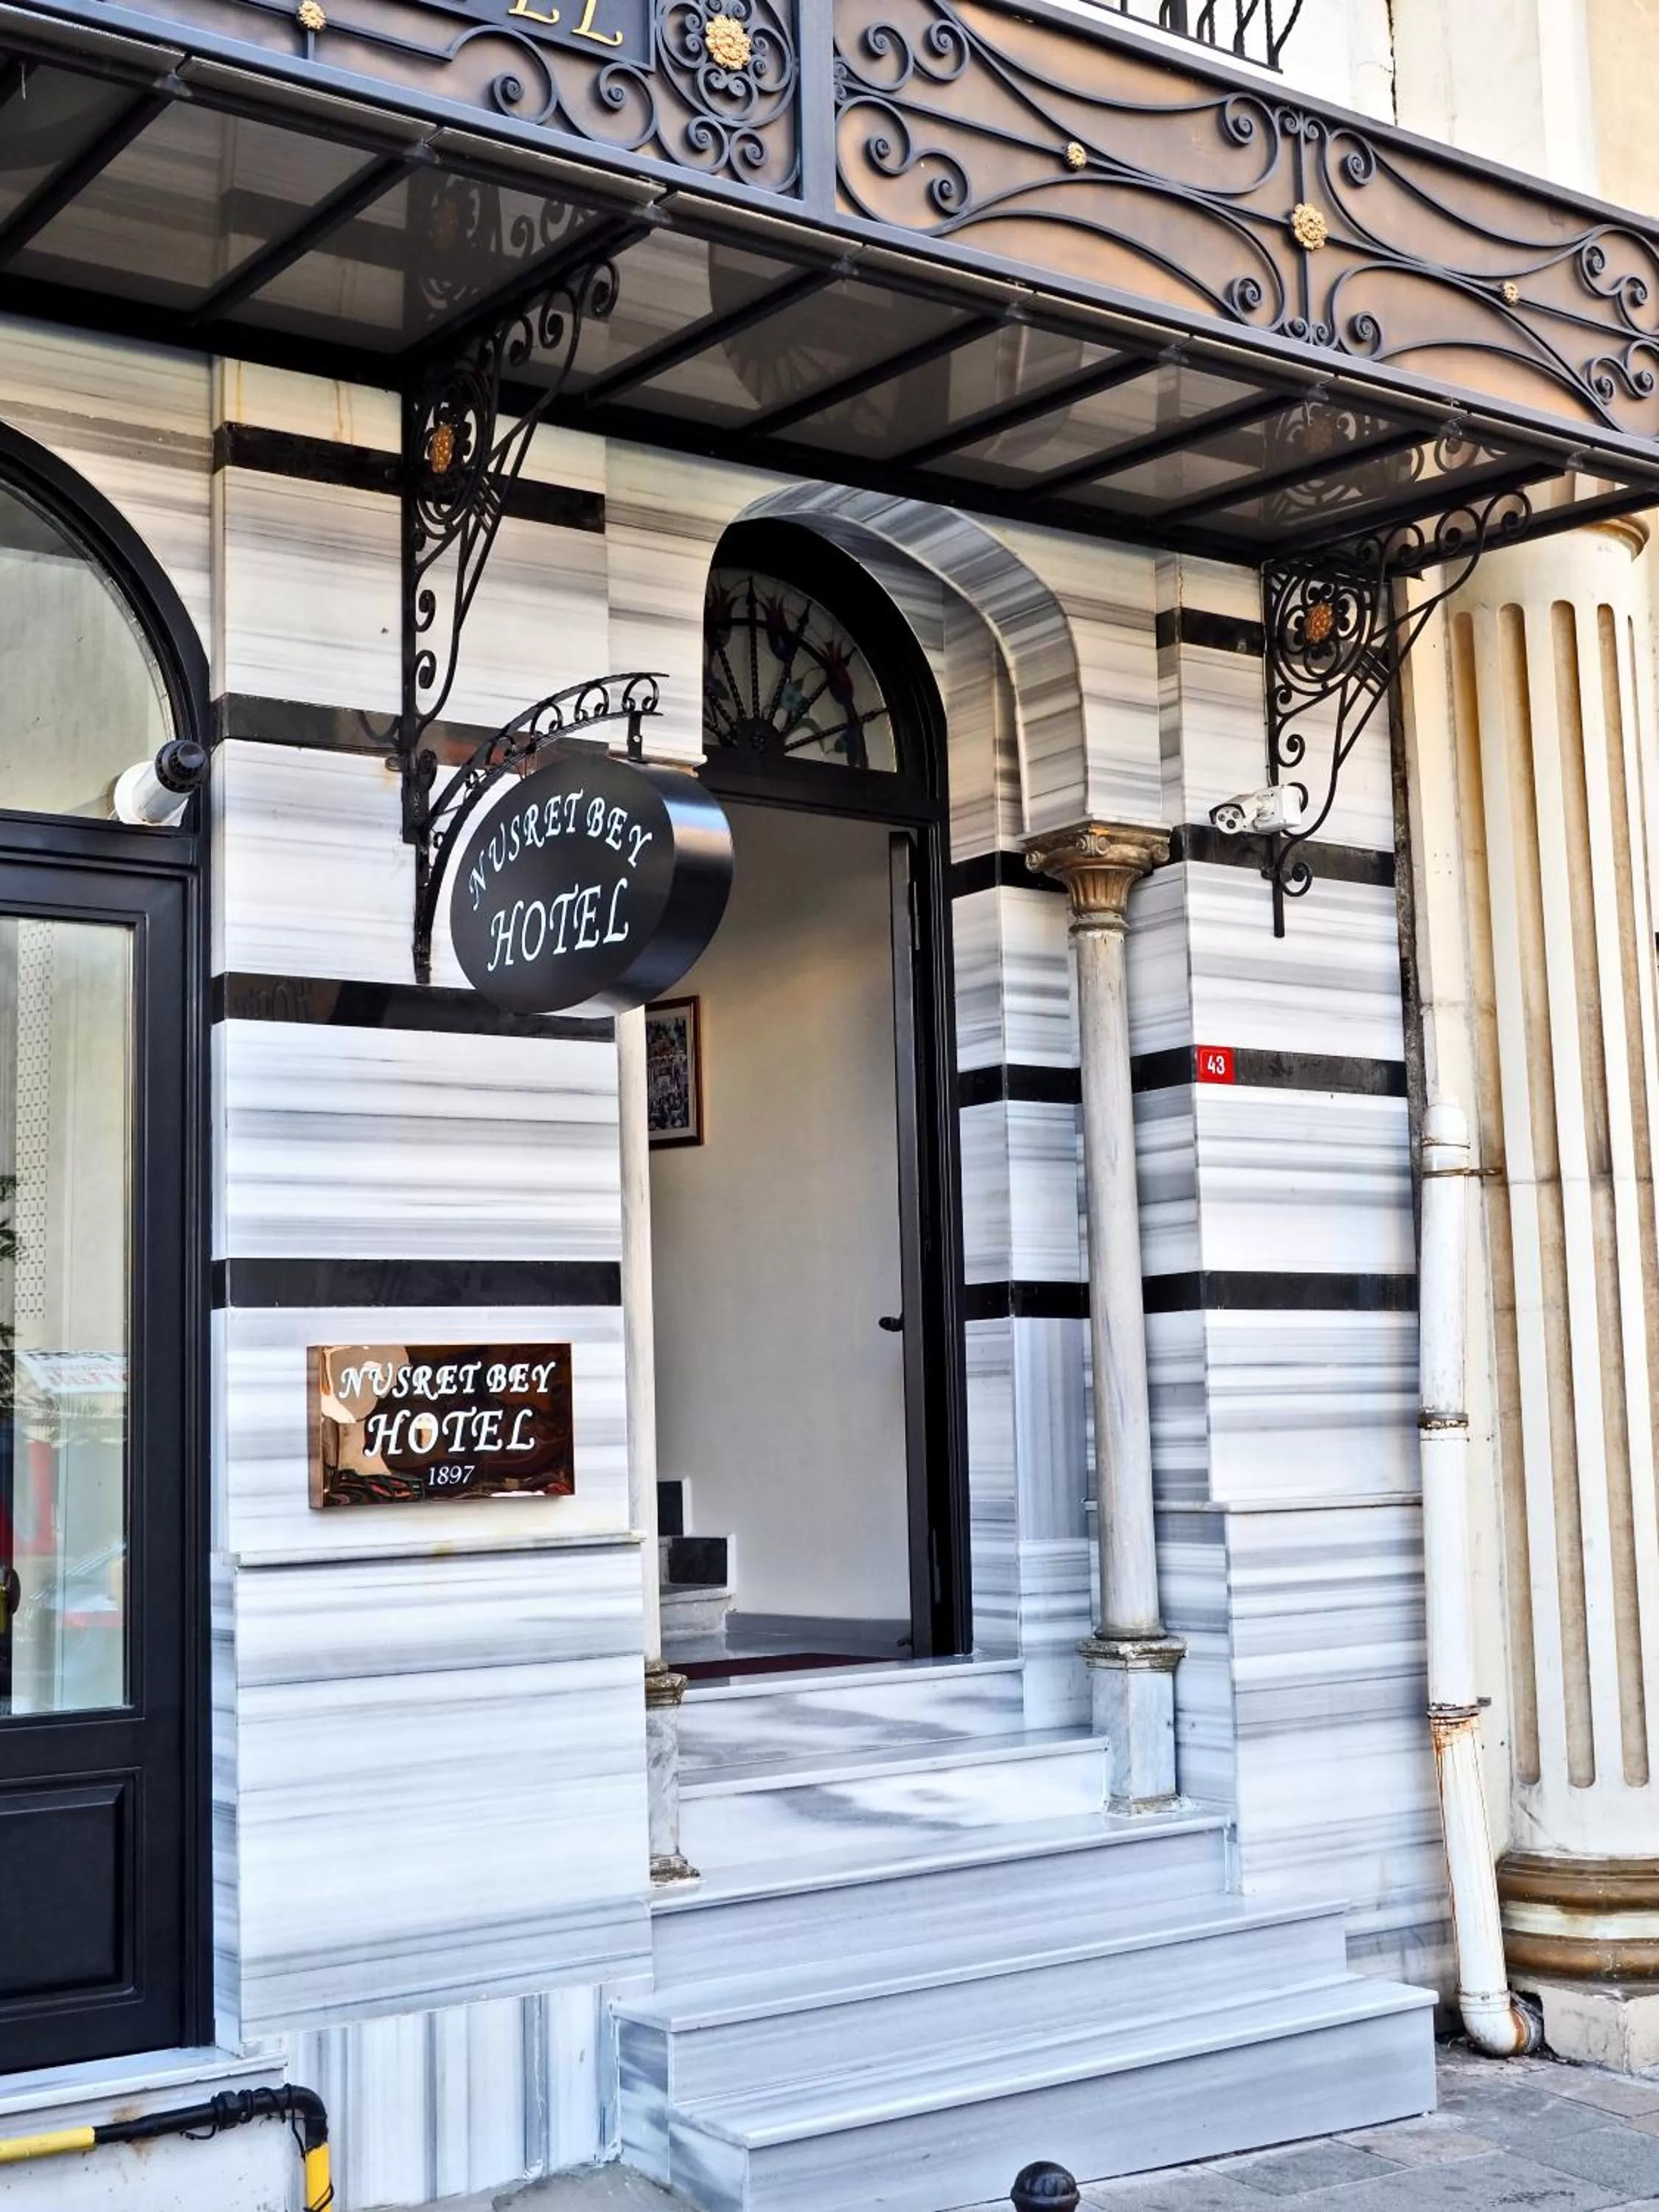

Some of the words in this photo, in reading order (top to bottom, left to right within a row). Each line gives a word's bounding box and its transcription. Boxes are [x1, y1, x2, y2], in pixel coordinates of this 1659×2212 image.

[468, 789, 584, 911] NUSRET
[586, 796, 653, 868] BEY
[487, 877, 630, 973] HOTEL
[1206, 1054, 1225, 1074] 43
[338, 1361, 481, 1400] NUSRET
[486, 1362, 556, 1394] BEY
[364, 1406, 535, 1458] HOTEL
[428, 1465, 475, 1486] 1897
